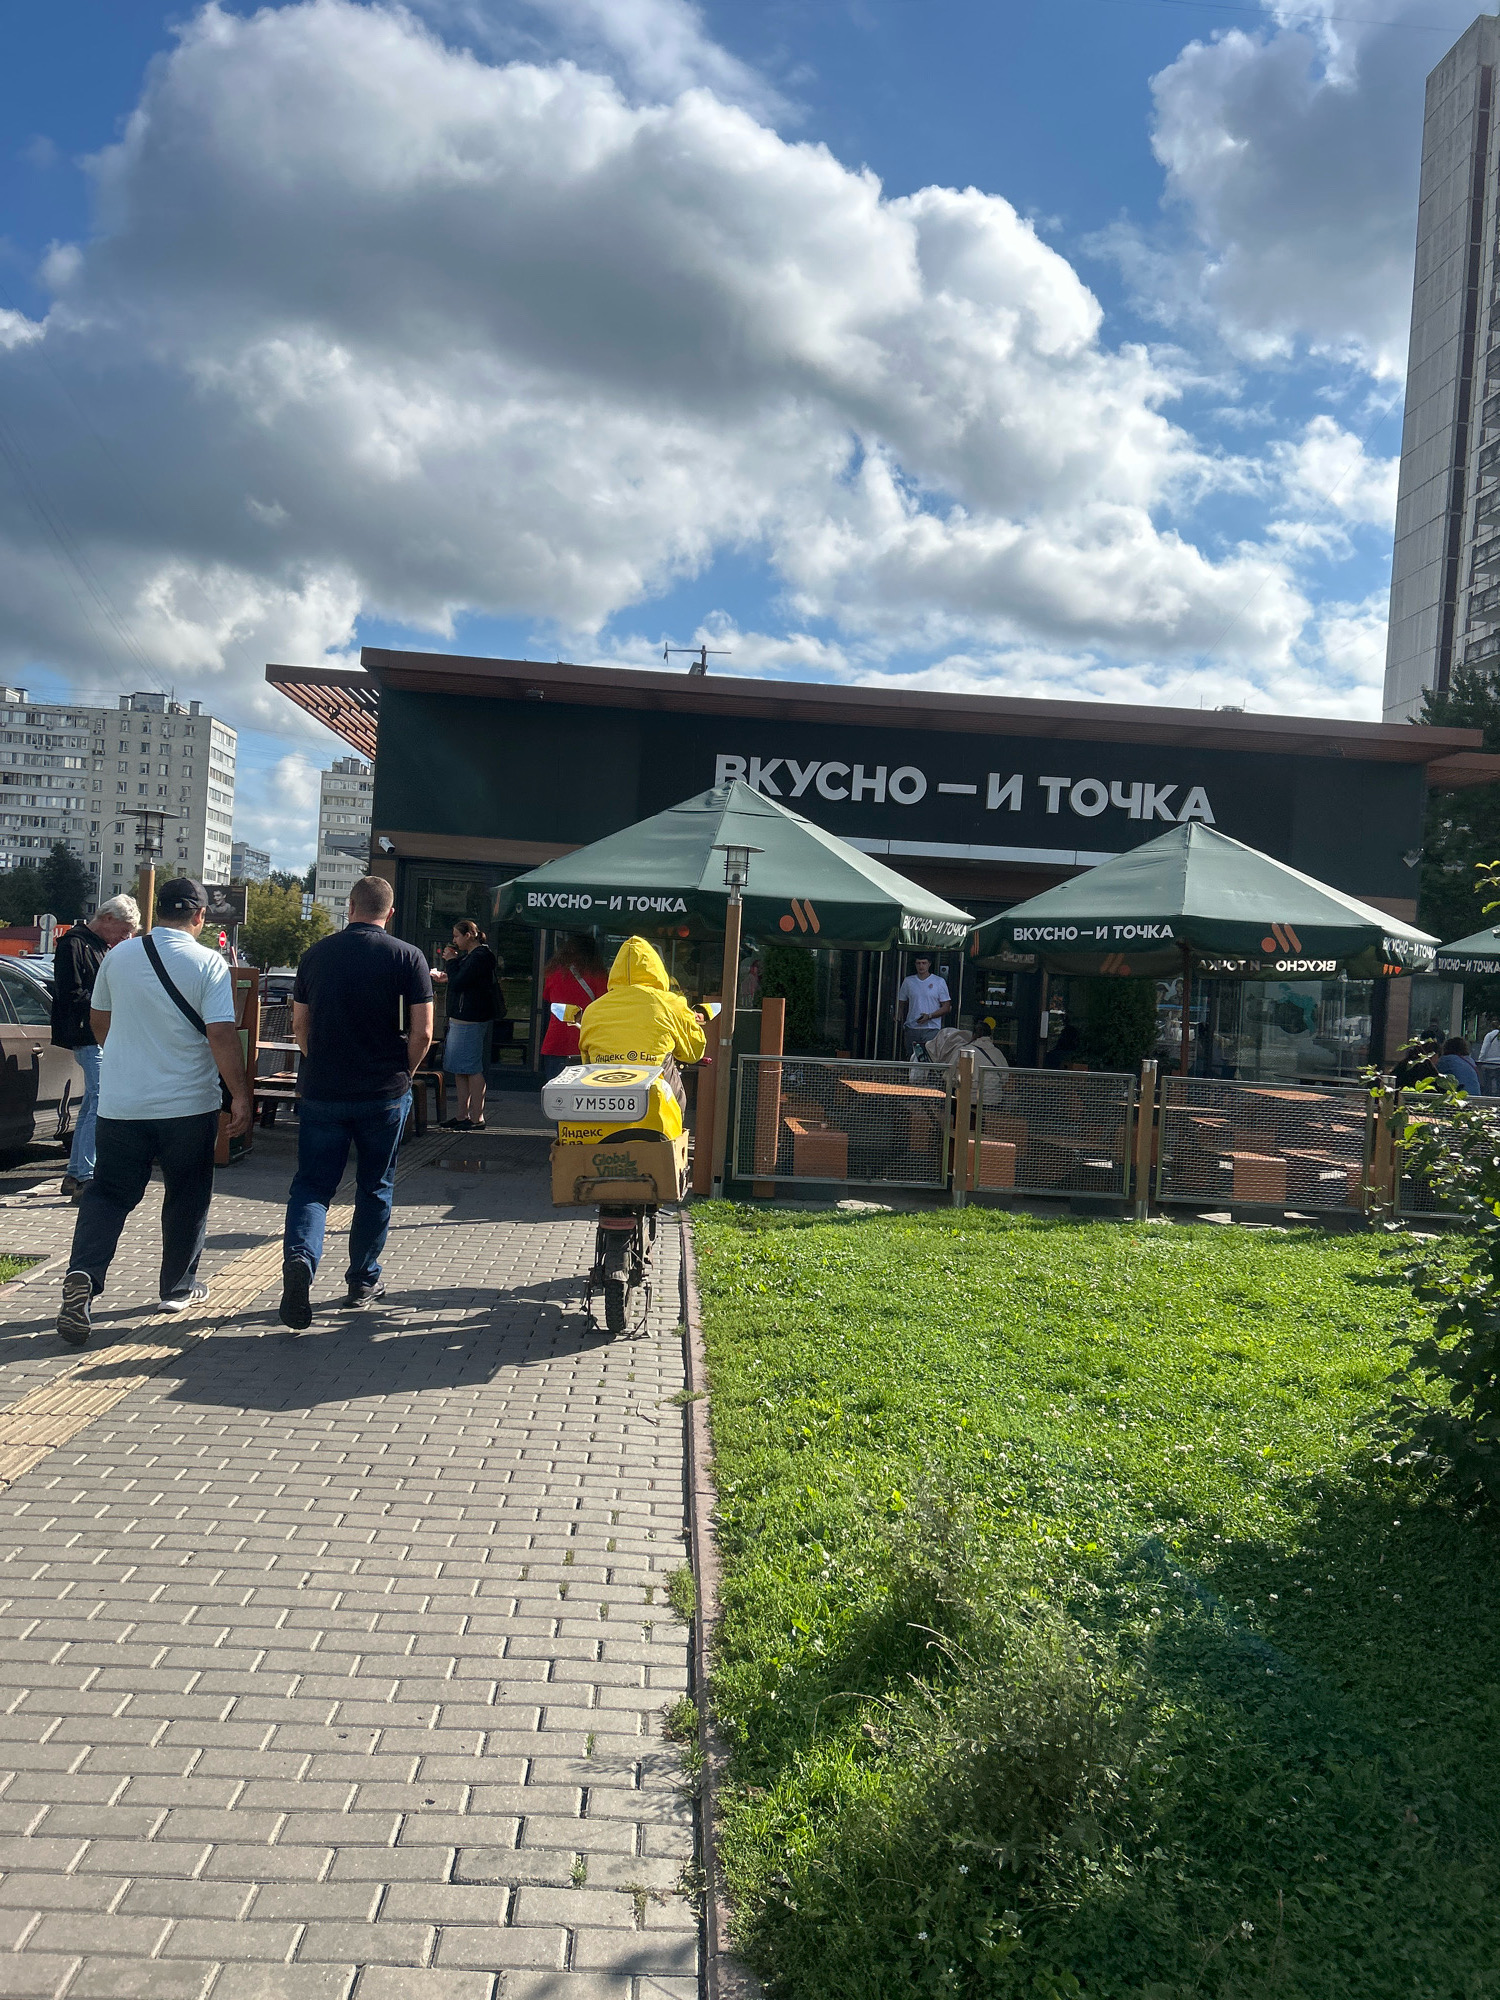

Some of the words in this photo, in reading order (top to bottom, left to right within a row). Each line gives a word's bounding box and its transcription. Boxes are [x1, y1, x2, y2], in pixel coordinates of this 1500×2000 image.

[715, 754, 927, 805] ВКУСНО
[986, 773, 1023, 811] И
[1038, 776, 1216, 824] ТОЧКА
[527, 892, 592, 910] ВКУСНО
[609, 896, 622, 910] И
[627, 896, 687, 912] ТОЧКА
[902, 915, 933, 932] ВКУСНО
[1013, 926, 1078, 941] ВКУСНО
[1095, 926, 1108, 940] И
[1113, 925, 1174, 940] ТОЧКА
[595, 1053, 625, 1063] Яндекс
[640, 1051, 657, 1062] Еда
[575, 1097, 635, 1111] УМ5508
[561, 1126, 603, 1139] Яндекс
[592, 1151, 630, 1166] Global
[596, 1164, 638, 1177] Village
